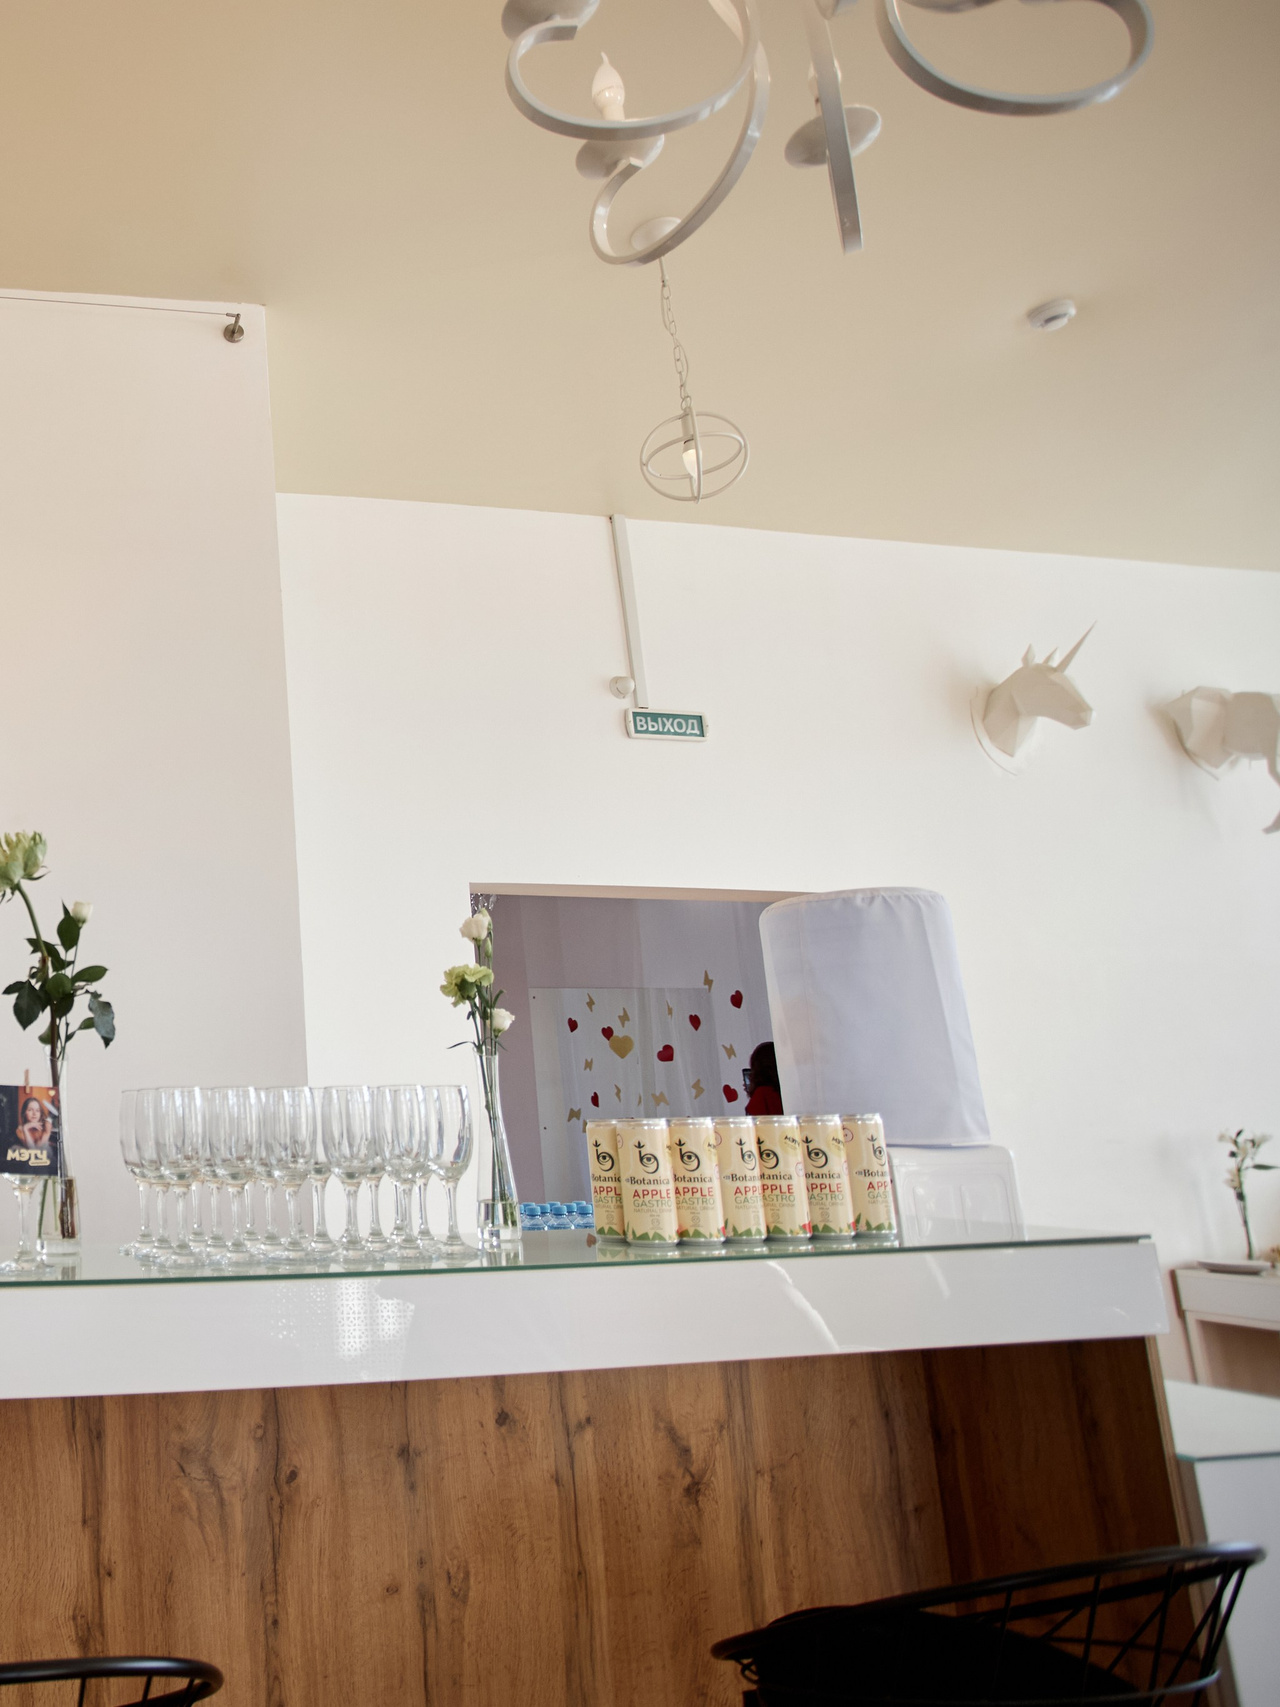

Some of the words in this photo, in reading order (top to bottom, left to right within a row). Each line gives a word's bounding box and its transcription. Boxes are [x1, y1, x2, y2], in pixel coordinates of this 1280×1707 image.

[635, 716, 700, 735] ВЫХОД
[805, 1170, 842, 1179] otanica
[630, 1176, 670, 1185] Botanica
[762, 1183, 795, 1195] PPLE
[867, 1181, 888, 1190] APP
[593, 1186, 622, 1196] APPL
[632, 1189, 671, 1199] APPLE
[675, 1186, 714, 1197] APPLE
[734, 1185, 761, 1196] APPL
[867, 1191, 888, 1199] GAS
[594, 1196, 622, 1204] GASTR
[734, 1196, 761, 1204] GAST
[763, 1194, 796, 1203] ASTRO
[808, 1193, 844, 1201] ASTRO
[633, 1199, 672, 1208] GASTRO
